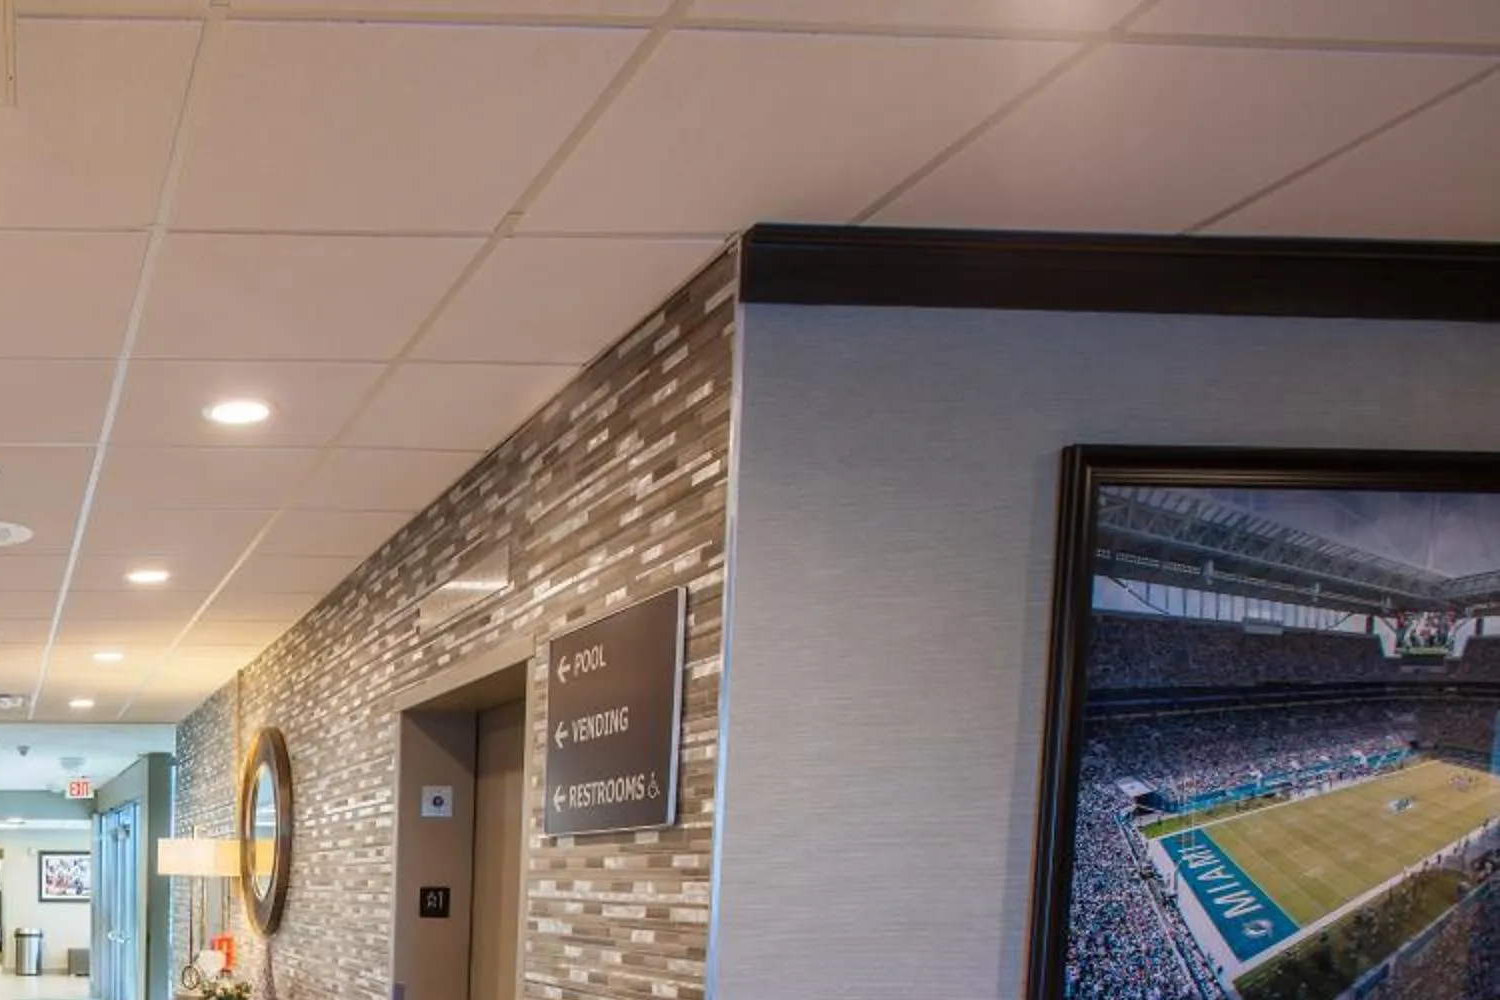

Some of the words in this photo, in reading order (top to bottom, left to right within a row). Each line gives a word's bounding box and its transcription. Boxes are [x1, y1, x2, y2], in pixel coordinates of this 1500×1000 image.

[574, 644, 607, 677] POOL
[571, 706, 629, 743] VENDING
[569, 773, 645, 809] RESTROOMS
[1177, 844, 1264, 919] MIAMI
